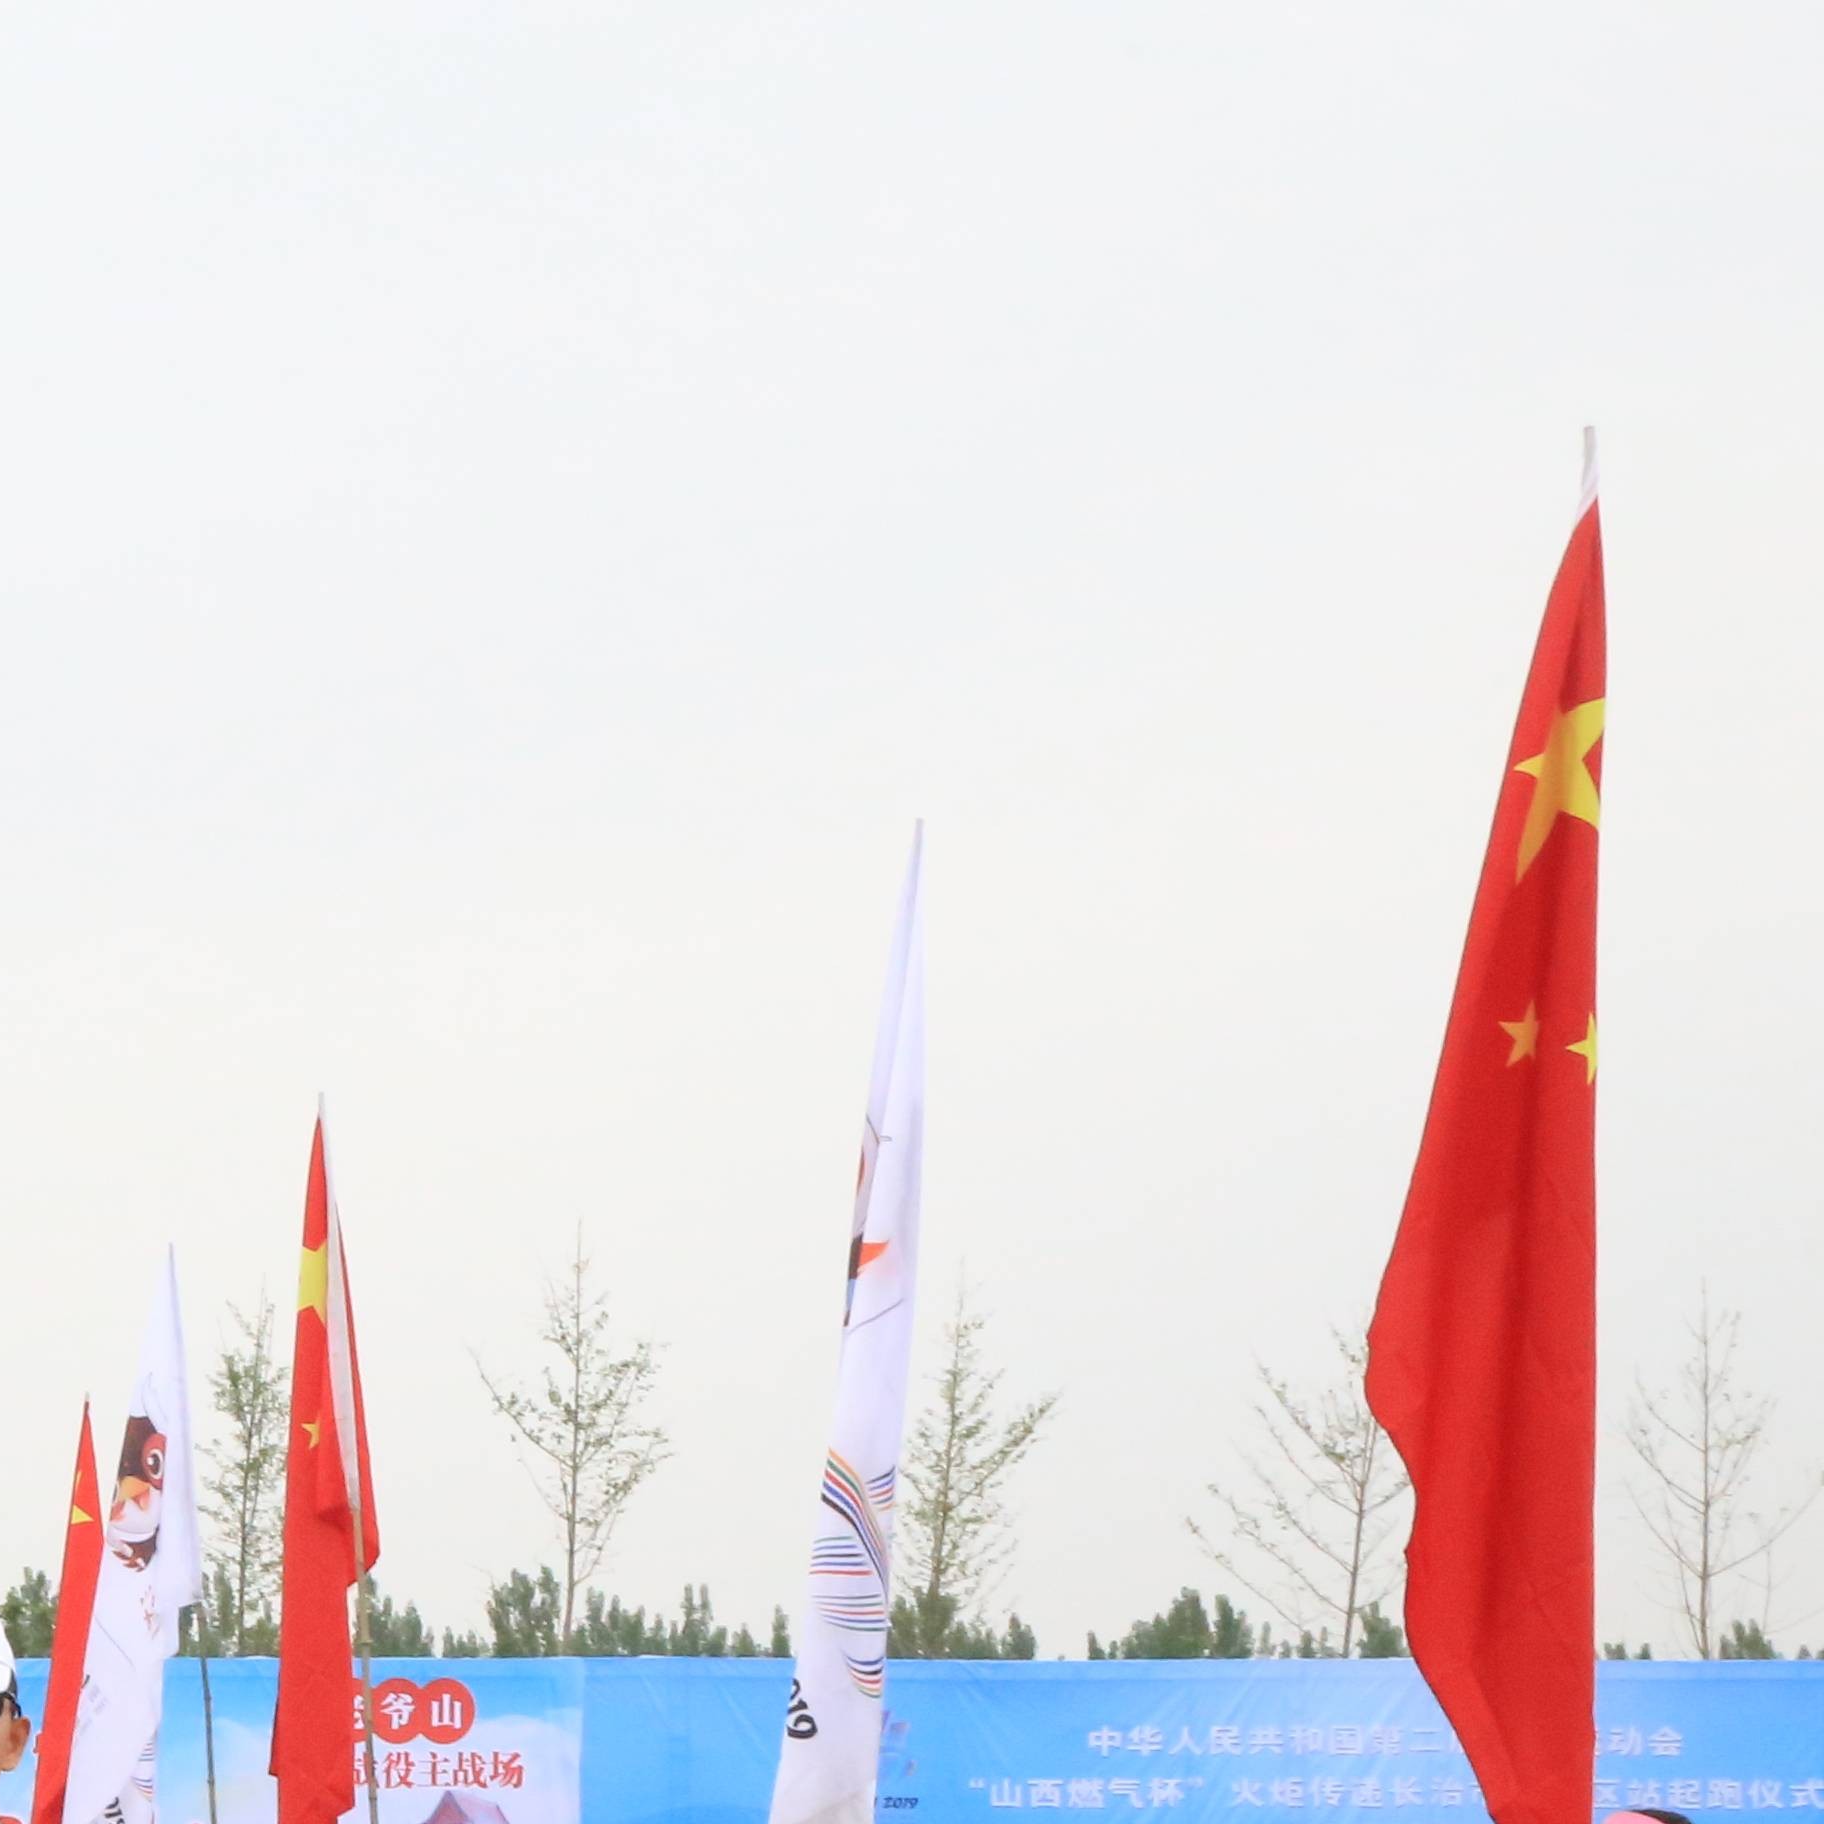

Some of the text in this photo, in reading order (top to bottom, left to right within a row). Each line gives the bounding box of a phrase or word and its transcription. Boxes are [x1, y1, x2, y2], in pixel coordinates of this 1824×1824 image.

[1087, 1724, 1682, 1758] 中华人民共和国第二动会
[1231, 1775, 1824, 1810] 火炬传递长治区站起跑仪式
